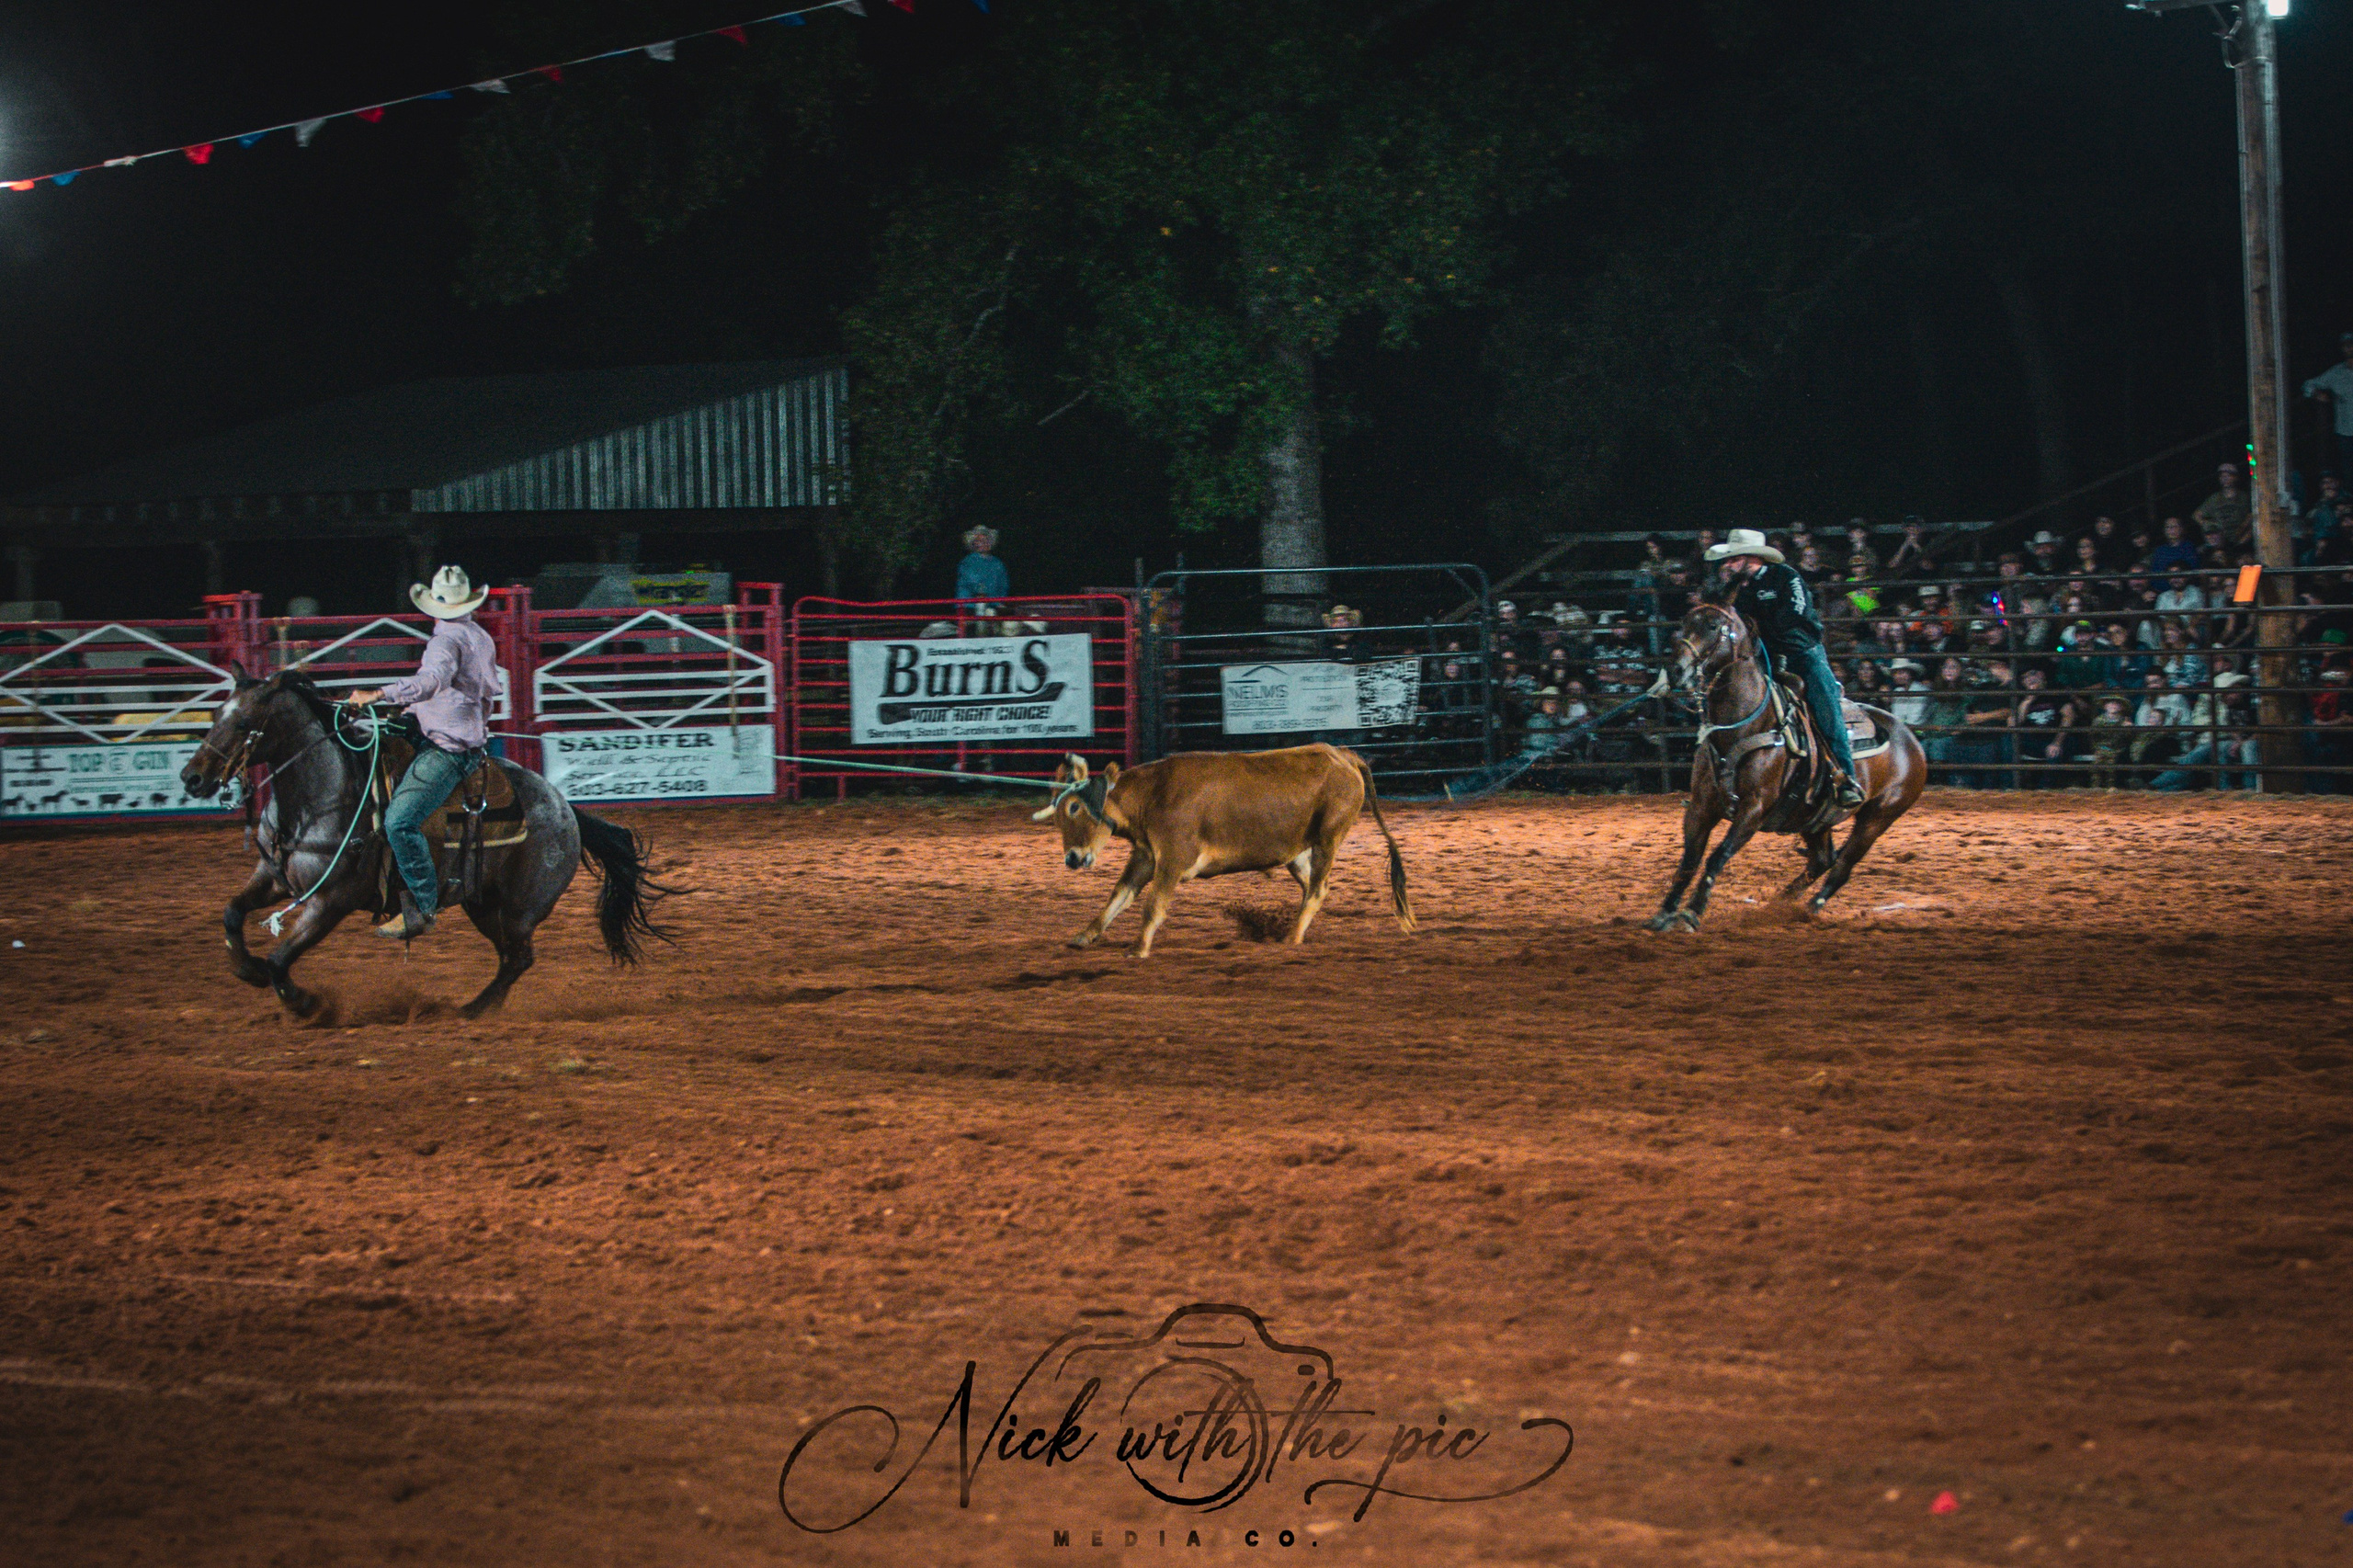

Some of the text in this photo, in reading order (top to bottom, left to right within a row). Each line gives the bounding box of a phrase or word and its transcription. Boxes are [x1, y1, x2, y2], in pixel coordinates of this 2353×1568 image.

[910, 705, 1052, 723] YOUR RIGHT CHOICE!
[867, 728, 913, 739] Serving
[917, 726, 949, 737] South
[952, 725, 1000, 736] Carolina
[1002, 724, 1018, 734] for
[1044, 723, 1079, 735] years
[558, 733, 714, 752] SANDIFER
[67, 753, 106, 773] TOP
[619, 755, 642, 766] &
[642, 754, 712, 768] Septic
[562, 767, 709, 782] Serce LLC
